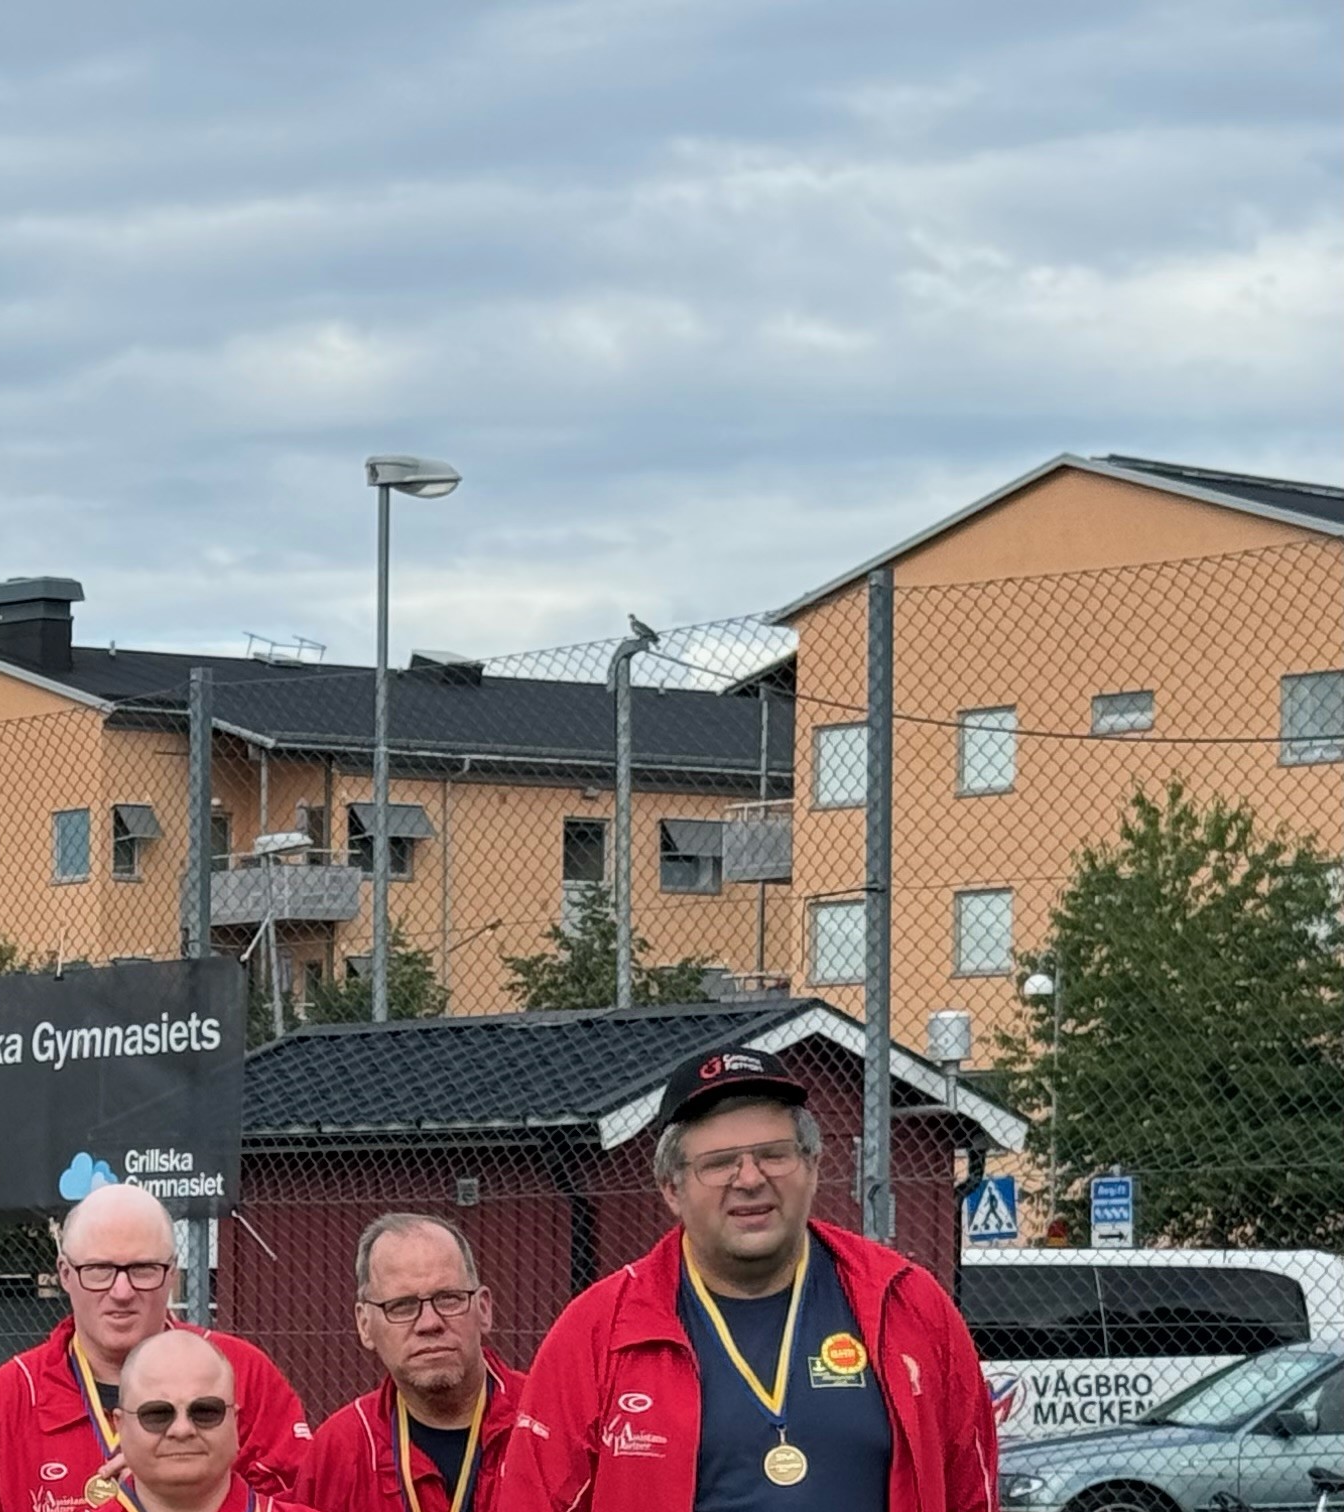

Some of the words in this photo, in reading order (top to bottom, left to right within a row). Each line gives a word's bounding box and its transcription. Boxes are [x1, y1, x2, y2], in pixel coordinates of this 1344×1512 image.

[32, 1011, 222, 1071] Gymnasiets
[124, 1148, 194, 1174] Grillska
[1031, 1371, 1152, 1398] VÅGBRO
